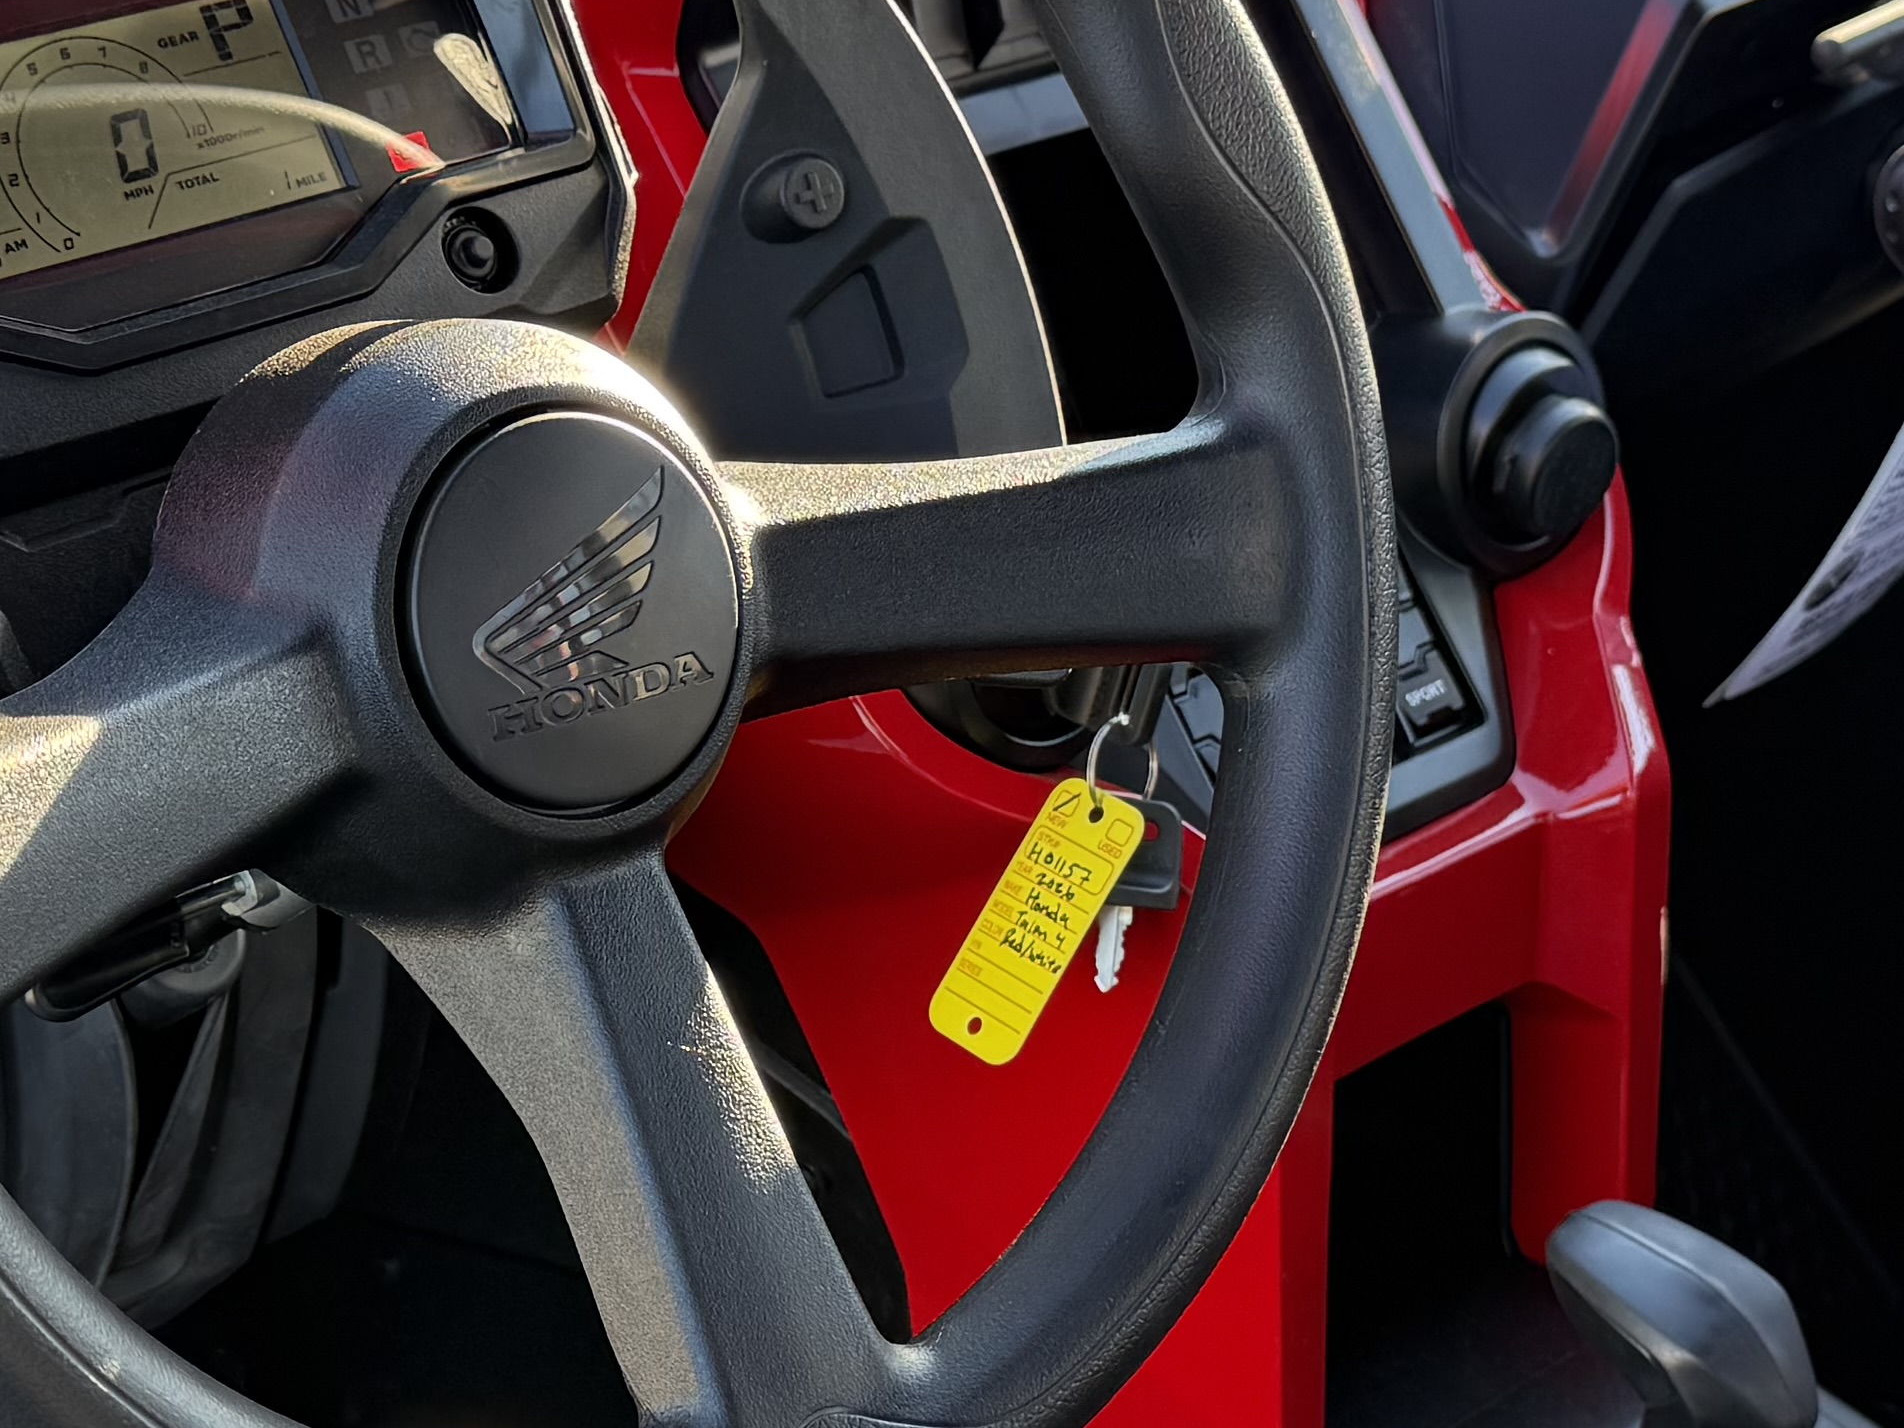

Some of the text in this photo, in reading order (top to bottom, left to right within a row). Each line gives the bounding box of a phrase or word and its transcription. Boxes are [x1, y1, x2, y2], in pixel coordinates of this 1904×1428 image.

[158, 31, 199, 49] GEAR
[60, 47, 71, 60] 6
[98, 47, 108, 58] 7
[355, 39, 382, 68] R
[27, 62, 38, 76] 5
[0, 132, 10, 145] 3
[192, 124, 207, 137] 10
[111, 108, 159, 184] 0
[8, 173, 20, 187] 2
[175, 173, 220, 191] TOTAL
[295, 172, 329, 189] MILE
[123, 185, 155, 201] MPH
[5, 239, 28, 254] AM
[63, 236, 75, 252] 0
[488, 650, 714, 742] HONDA
[1045, 812, 1069, 829] NEW
[1098, 840, 1122, 859] USED
[1025, 887, 1069, 930] Honda
